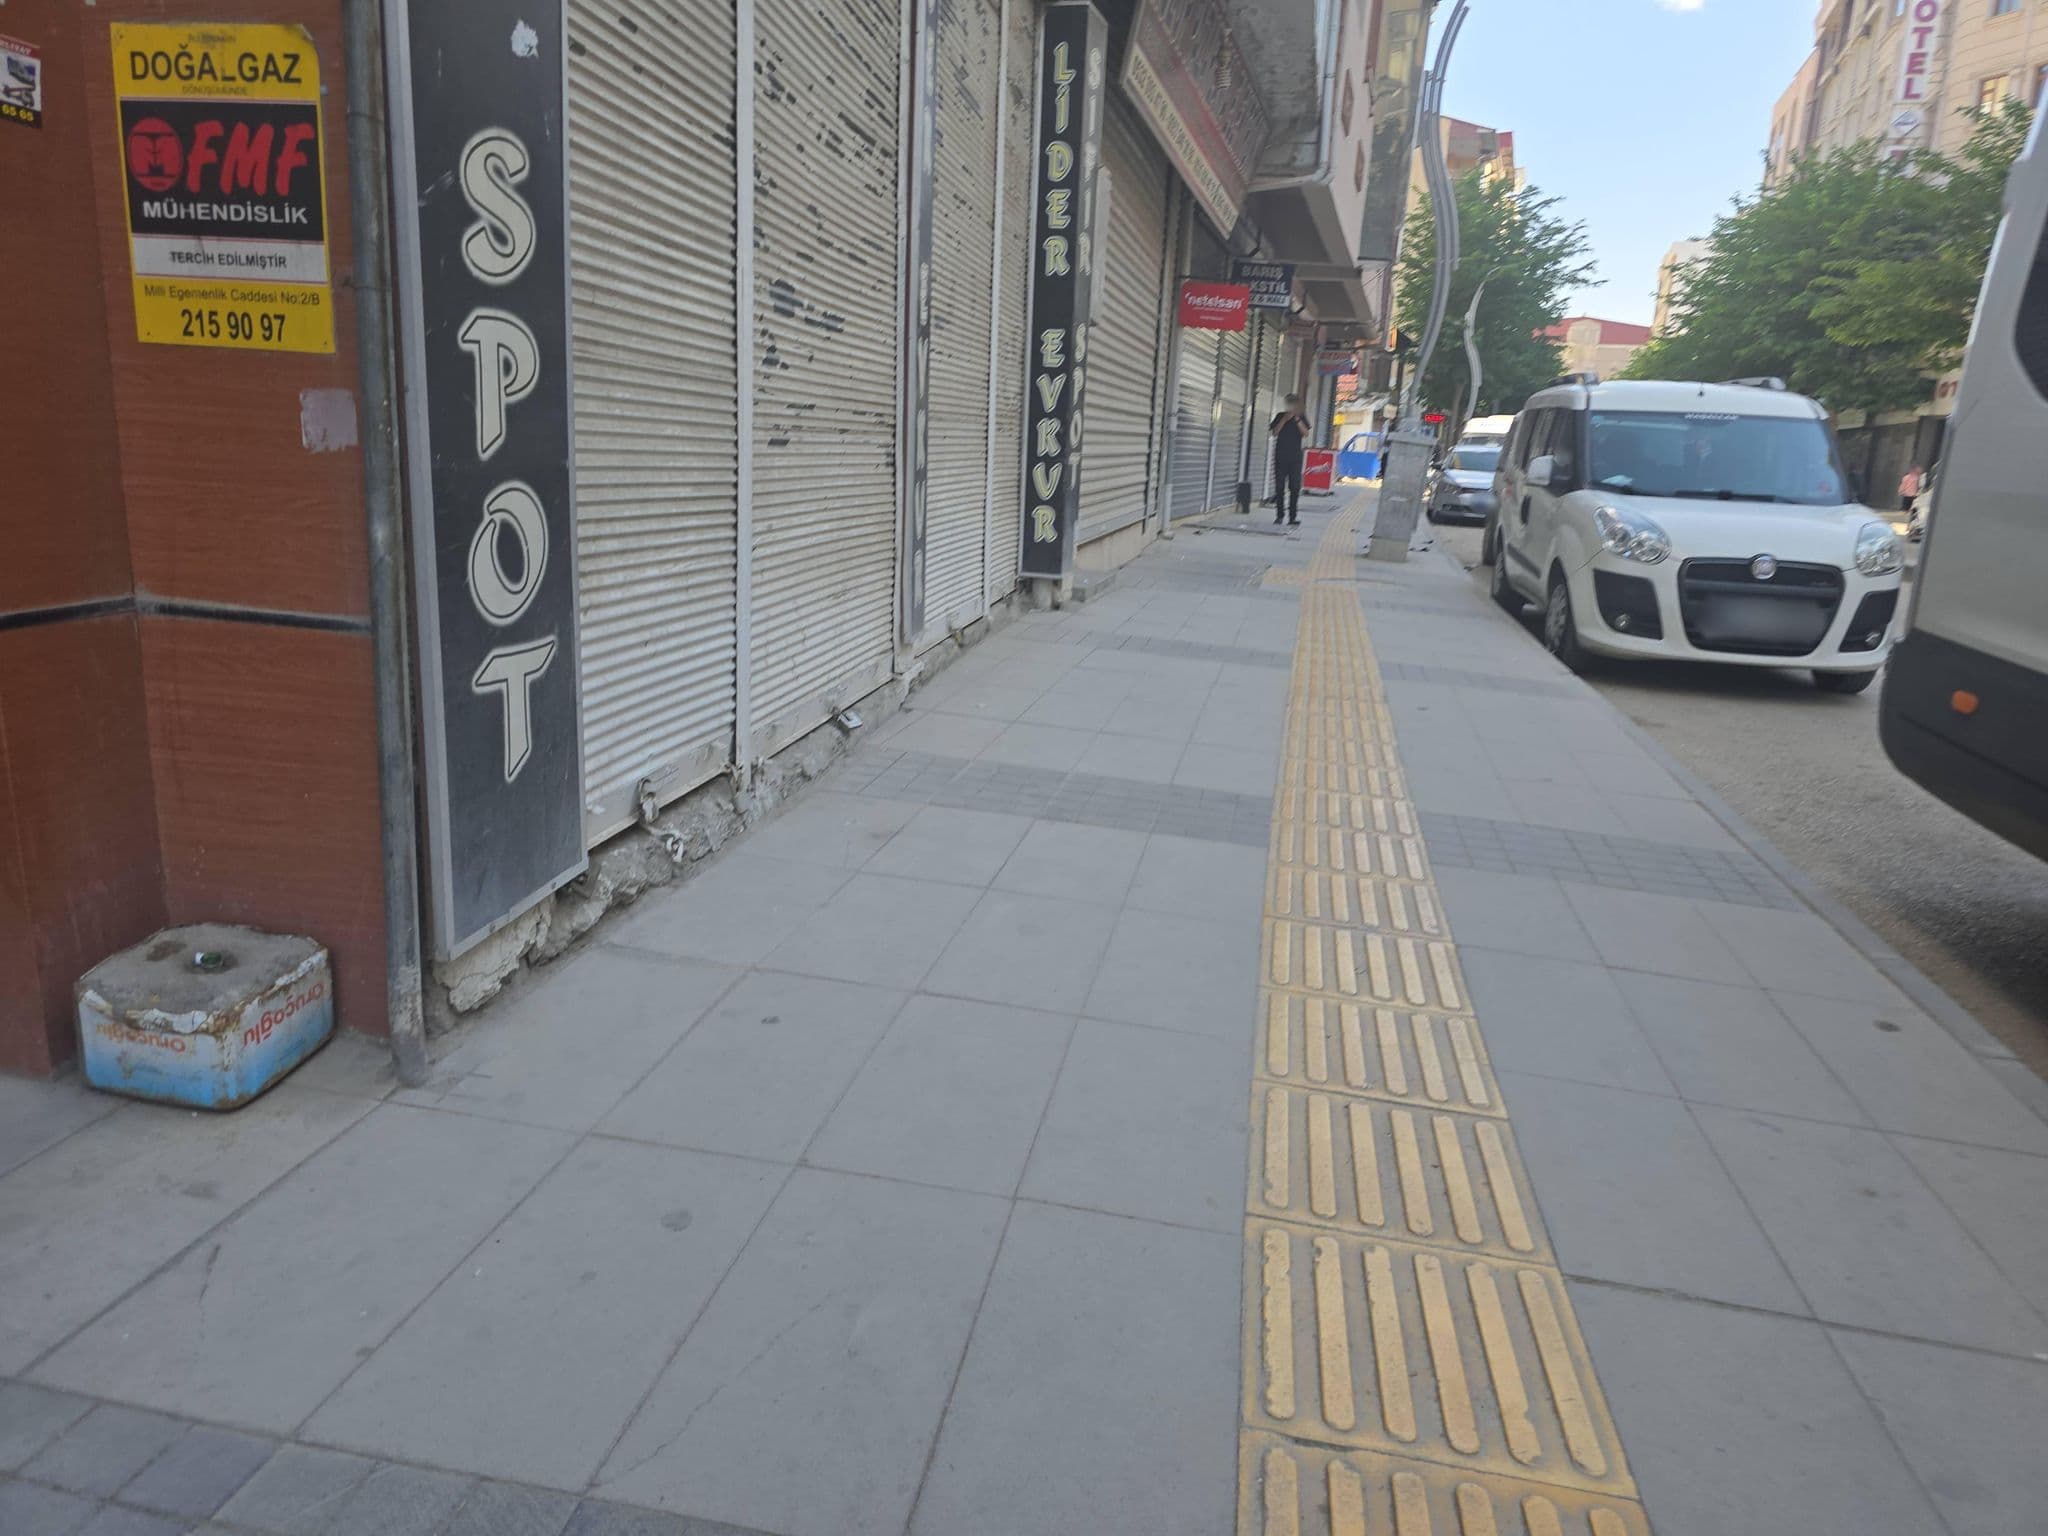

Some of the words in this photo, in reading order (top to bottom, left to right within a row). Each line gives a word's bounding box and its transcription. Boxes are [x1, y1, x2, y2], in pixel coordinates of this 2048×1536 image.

[130, 44, 302, 84] DOĞALGAZ
[186, 120, 316, 196] FMF
[1043, 41, 1076, 277] LİDER
[143, 197, 308, 225] MÜHENDİSLİK
[169, 250, 215, 266] TERCİH
[217, 252, 288, 269] EDİLMİŞTİR
[169, 286, 227, 302] Egemenlik
[230, 290, 277, 304] Caddesi
[181, 308, 221, 339] 215
[226, 311, 254, 341] 90
[259, 313, 286, 343] 97
[1068, 323, 1087, 489] SPOT
[460, 130, 559, 782] SPOT
